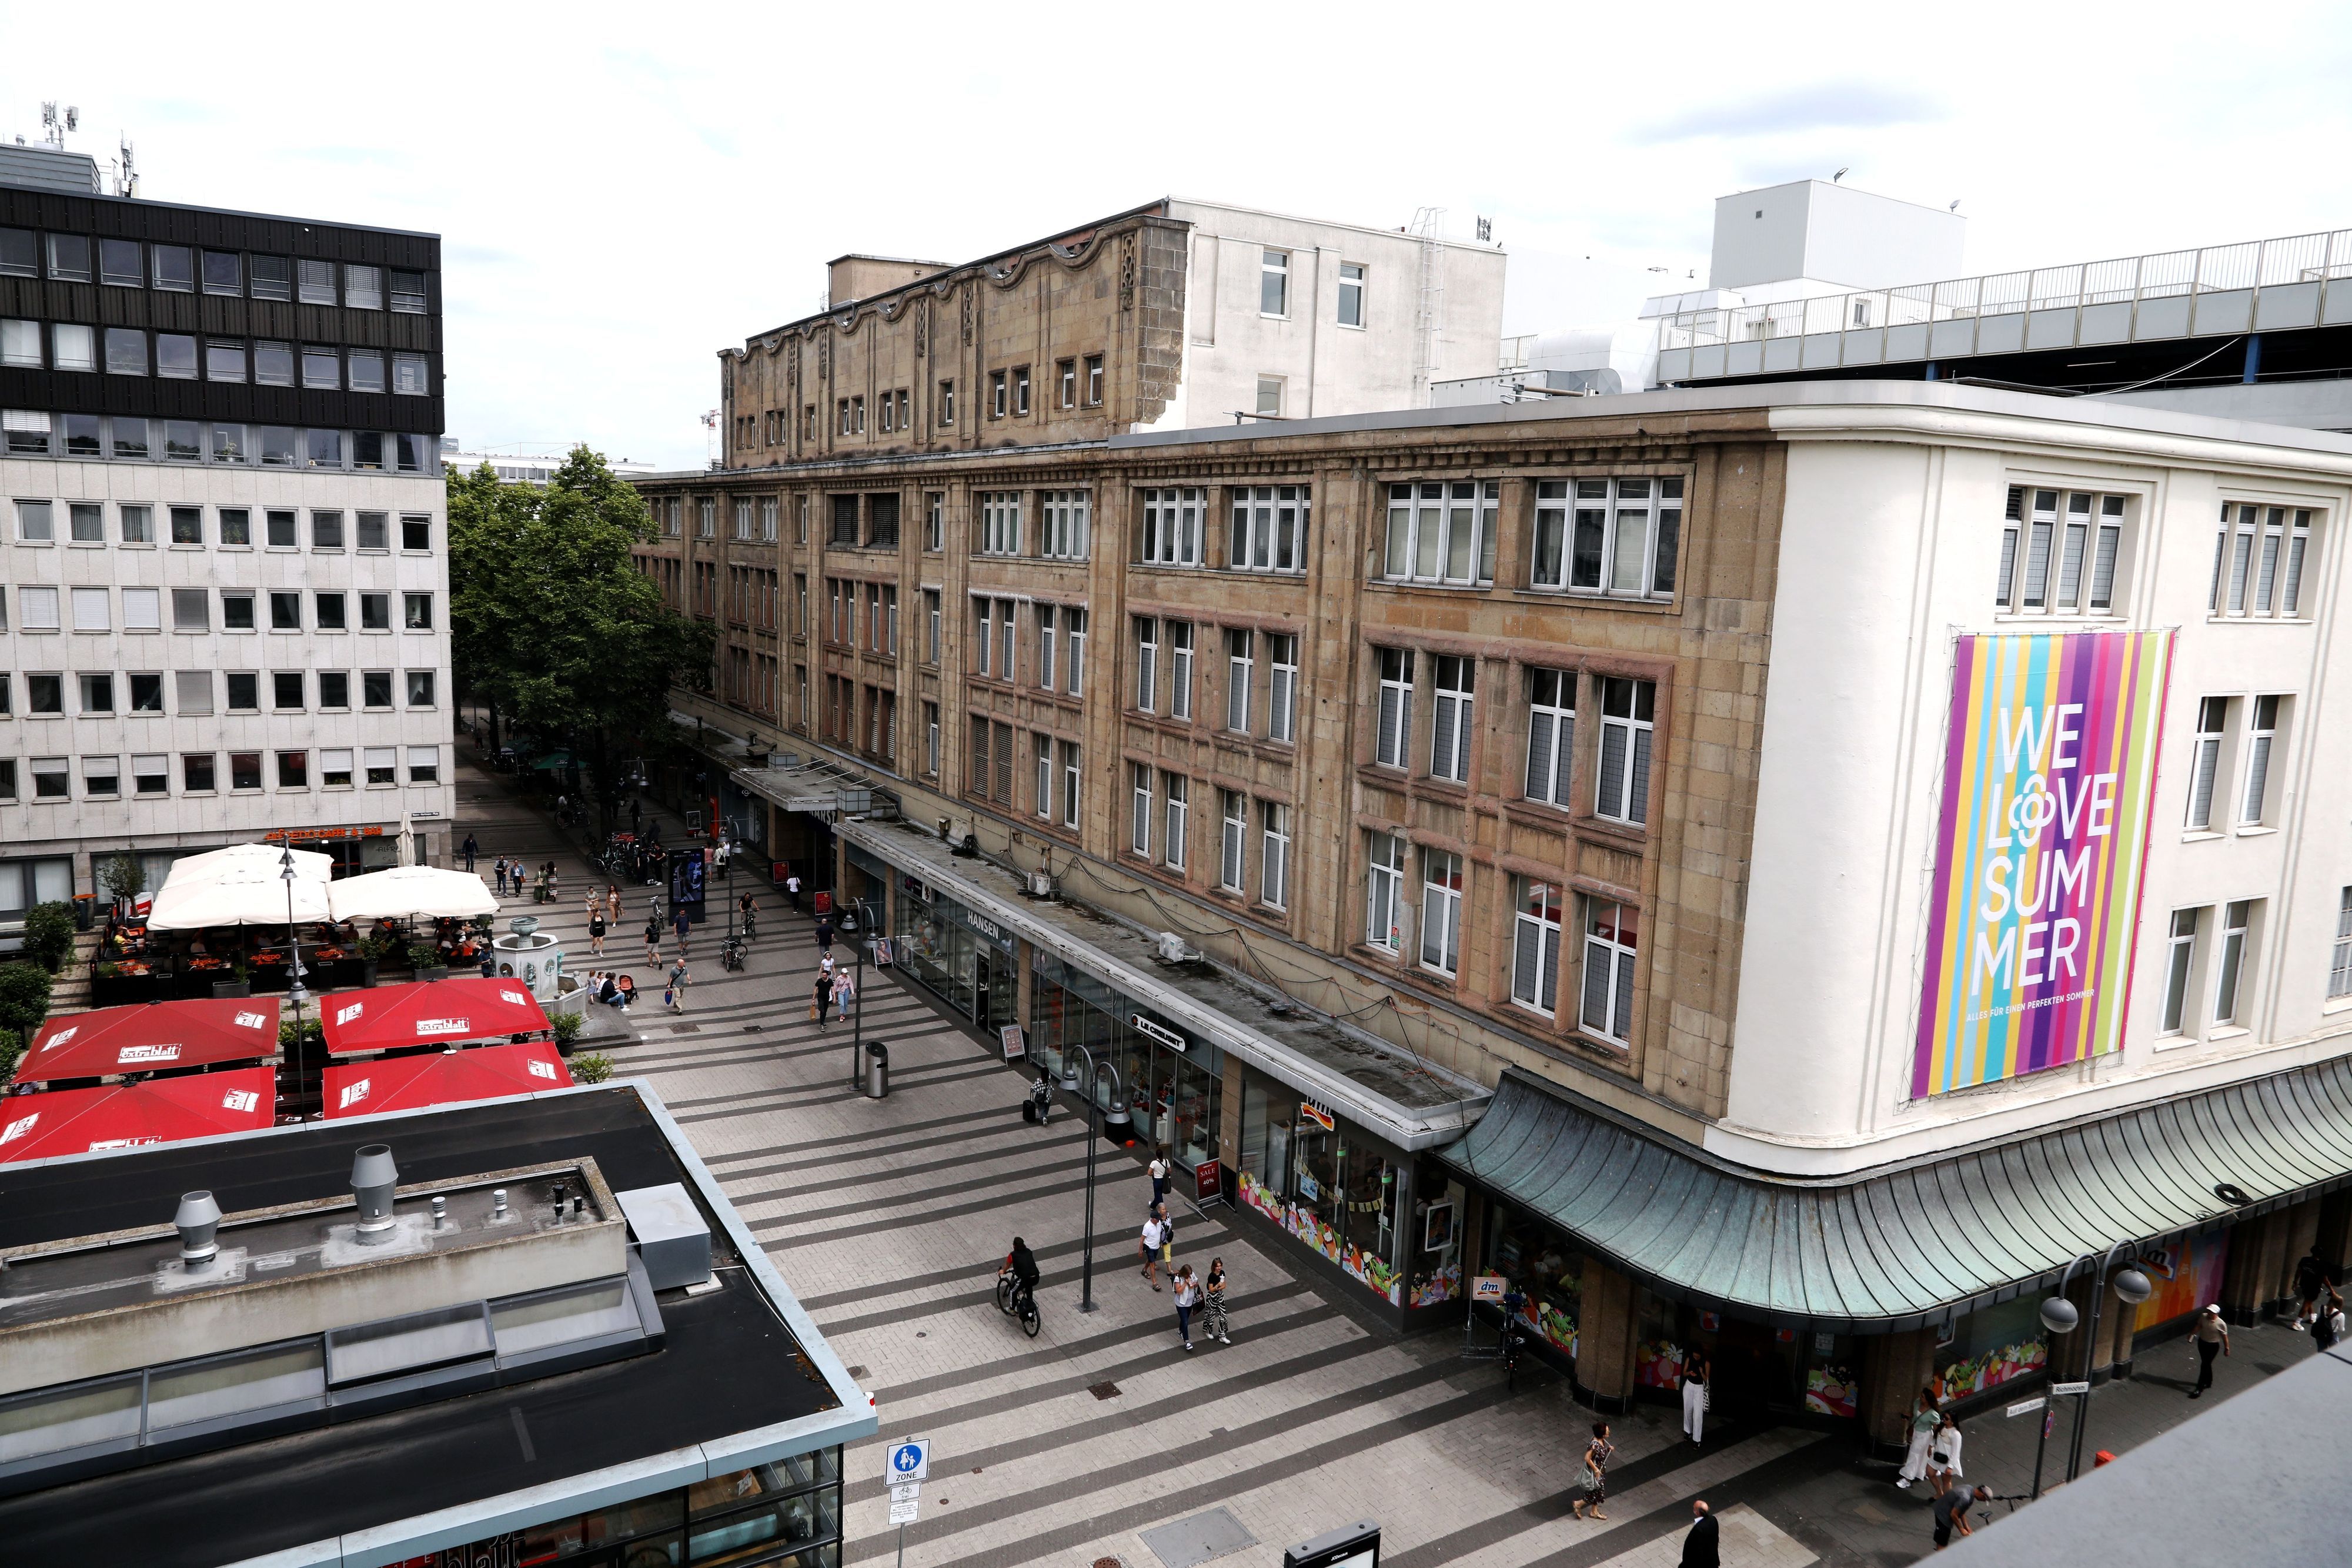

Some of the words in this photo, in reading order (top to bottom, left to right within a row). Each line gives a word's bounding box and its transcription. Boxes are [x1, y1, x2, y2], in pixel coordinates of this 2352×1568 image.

[2000, 703, 2083, 773] WE
[351, 828, 358, 837] &
[363, 825, 382, 835] BAR
[1980, 845, 2093, 922] SUM
[967, 910, 999, 940] HANSEN
[249, 953, 281, 961] ALFREDO
[1971, 917, 2081, 997] MER
[1966, 1011, 1987, 1022] ALLES
[1990, 1007, 2003, 1017] FÜR
[2005, 1003, 2026, 1014] EINEN
[2027, 995, 2064, 1009] PERFEKTEN
[2066, 989, 2094, 1002] SOMMER
[419, 1019, 467, 1031] extrablatt
[1141, 1021, 1149, 1031] LE
[1150, 1026, 1180, 1047] CREUSET
[121, 1045, 179, 1058] extrablatt
[1200, 1168, 1215, 1177] SALE
[1481, 1282, 1498, 1290] dm
[896, 1472, 917, 1482] ZONE
[1331, 1552, 1348, 1561] JCDecaux
